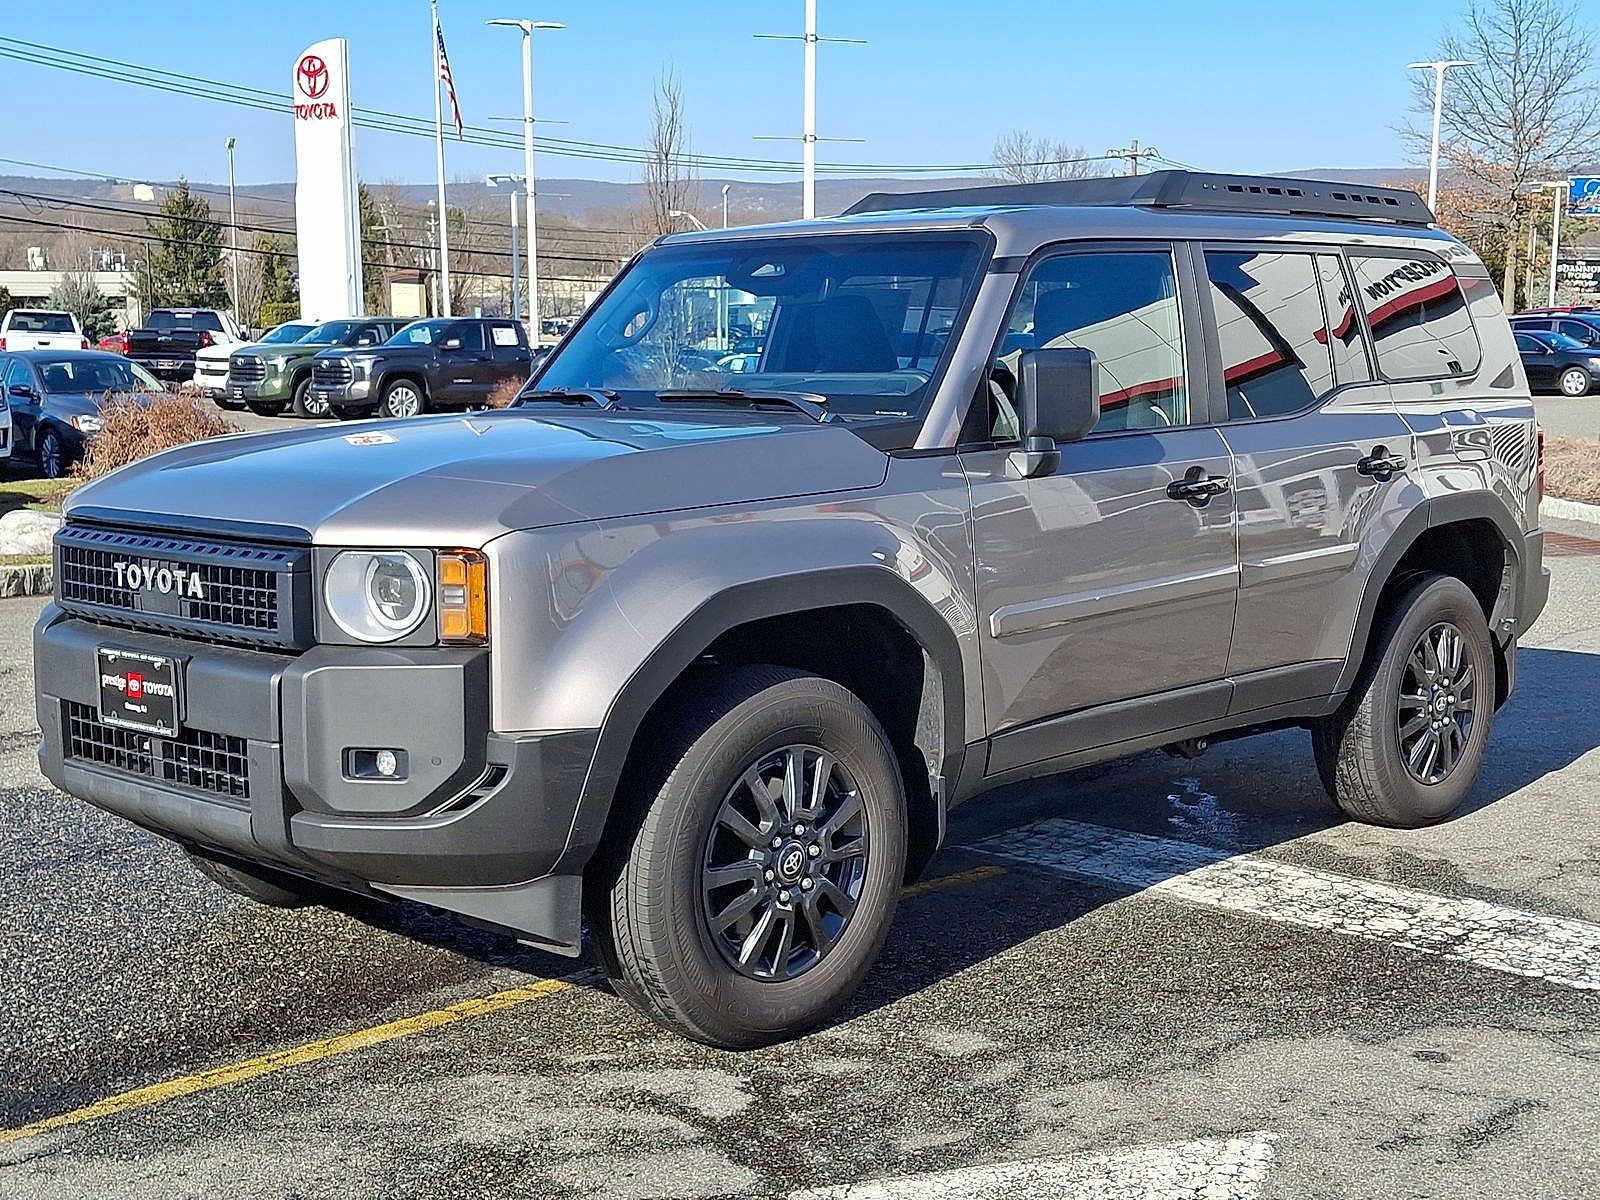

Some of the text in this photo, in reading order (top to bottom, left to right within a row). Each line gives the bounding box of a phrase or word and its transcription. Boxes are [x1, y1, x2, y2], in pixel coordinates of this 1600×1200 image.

[294, 103, 337, 120] TOYOTA
[113, 562, 204, 599] TOYOTA
[142, 681, 174, 698] TOYOTA
